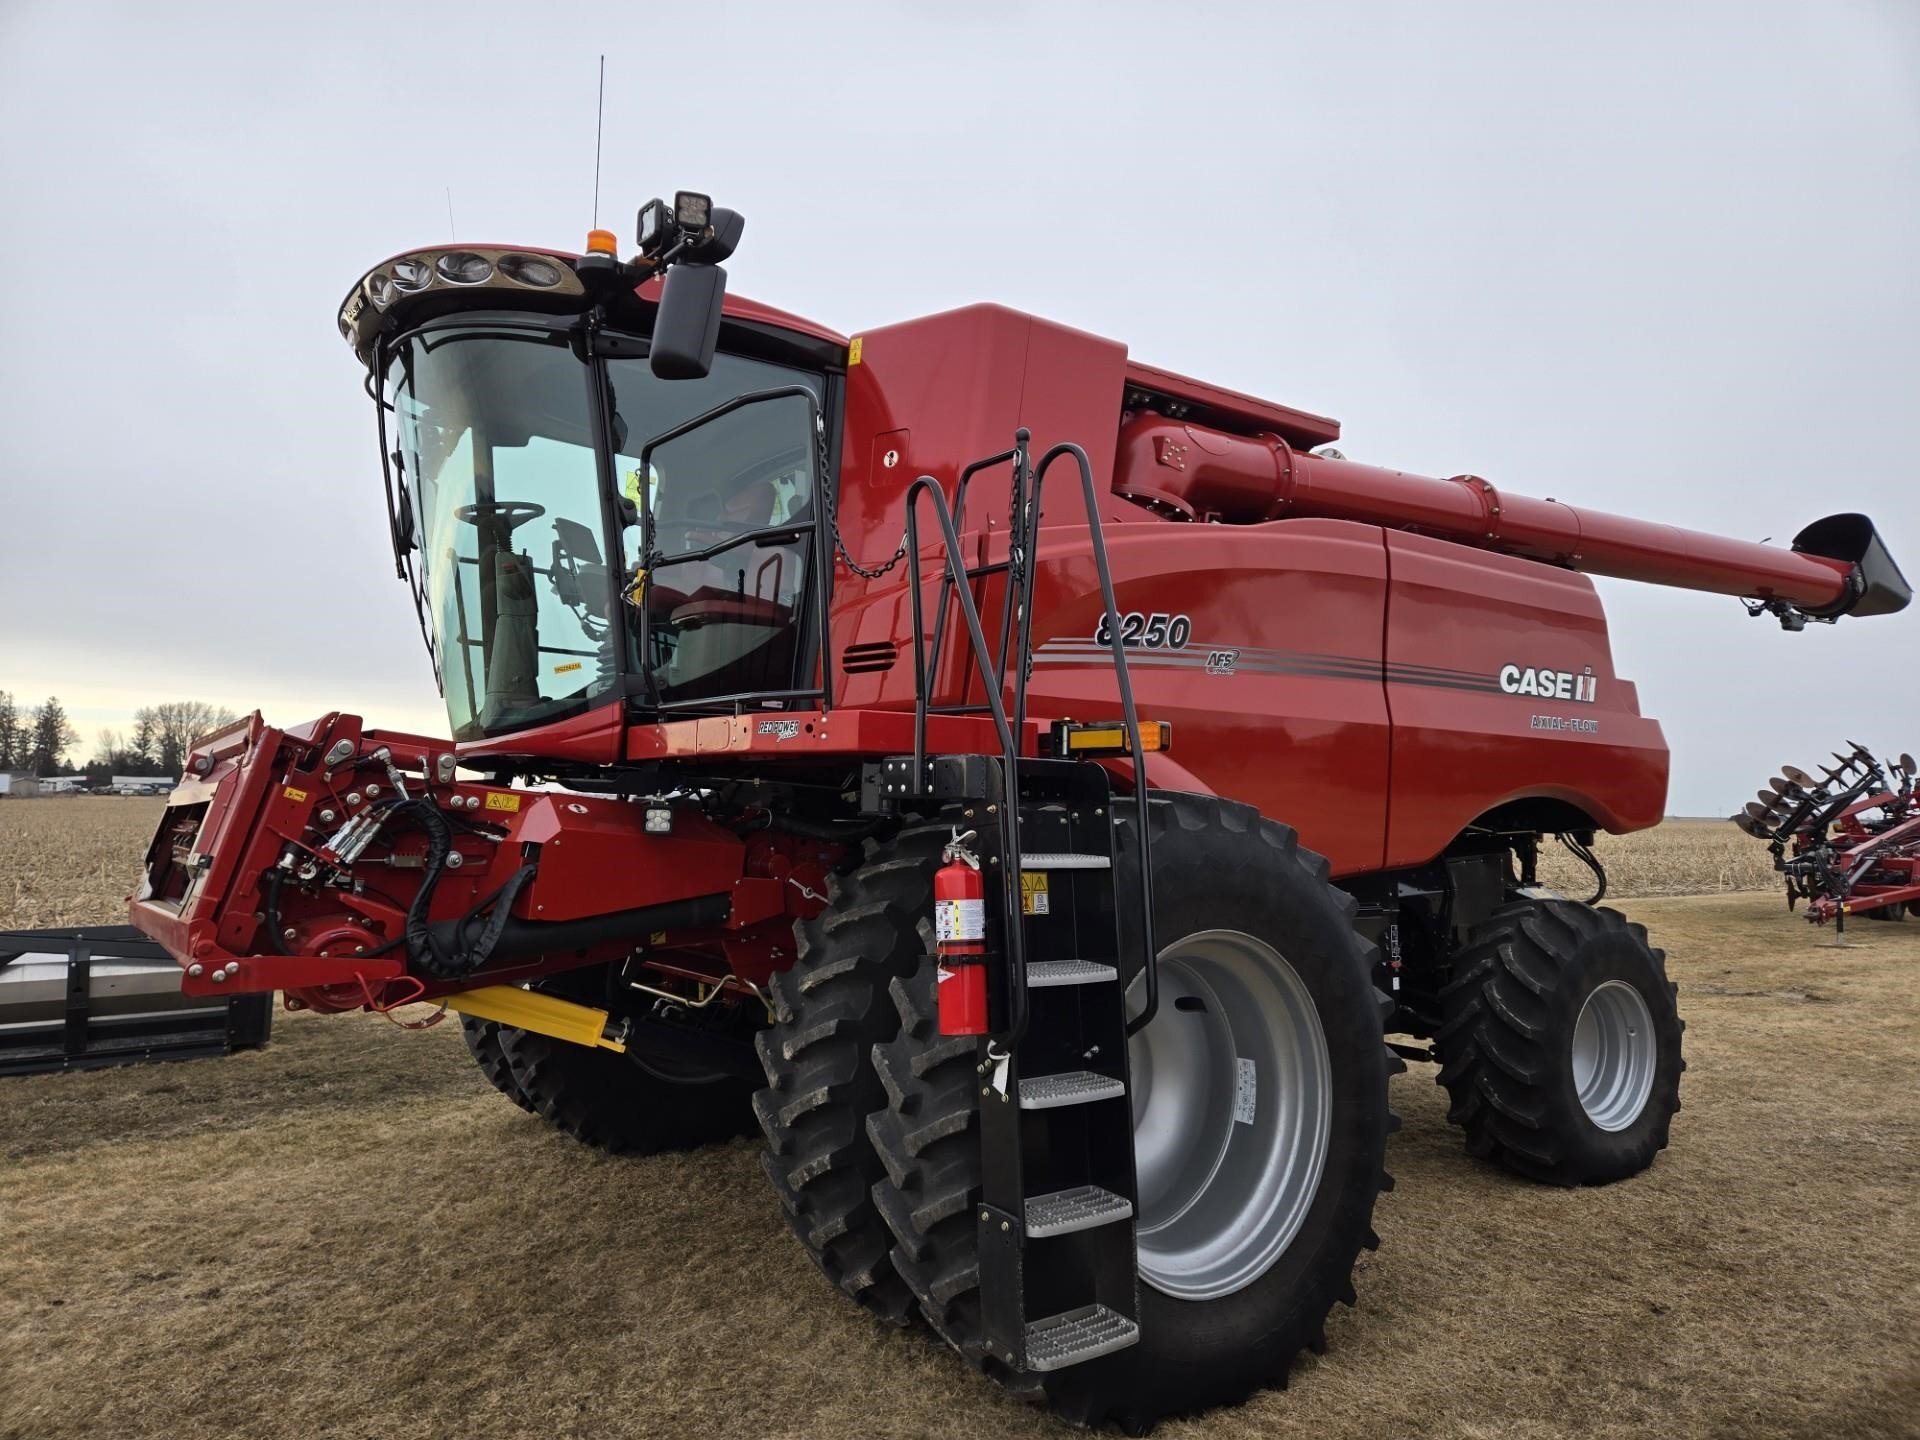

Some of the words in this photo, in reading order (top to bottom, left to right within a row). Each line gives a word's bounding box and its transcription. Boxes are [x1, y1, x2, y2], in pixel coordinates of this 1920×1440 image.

[1095, 612, 1191, 650] 8250
[1206, 650, 1233, 667] AFS
[1500, 664, 1573, 700] CASE
[758, 721, 774, 734] RED
[774, 720, 800, 734] POWER
[1531, 715, 1598, 732] AXIAL-FLOW
